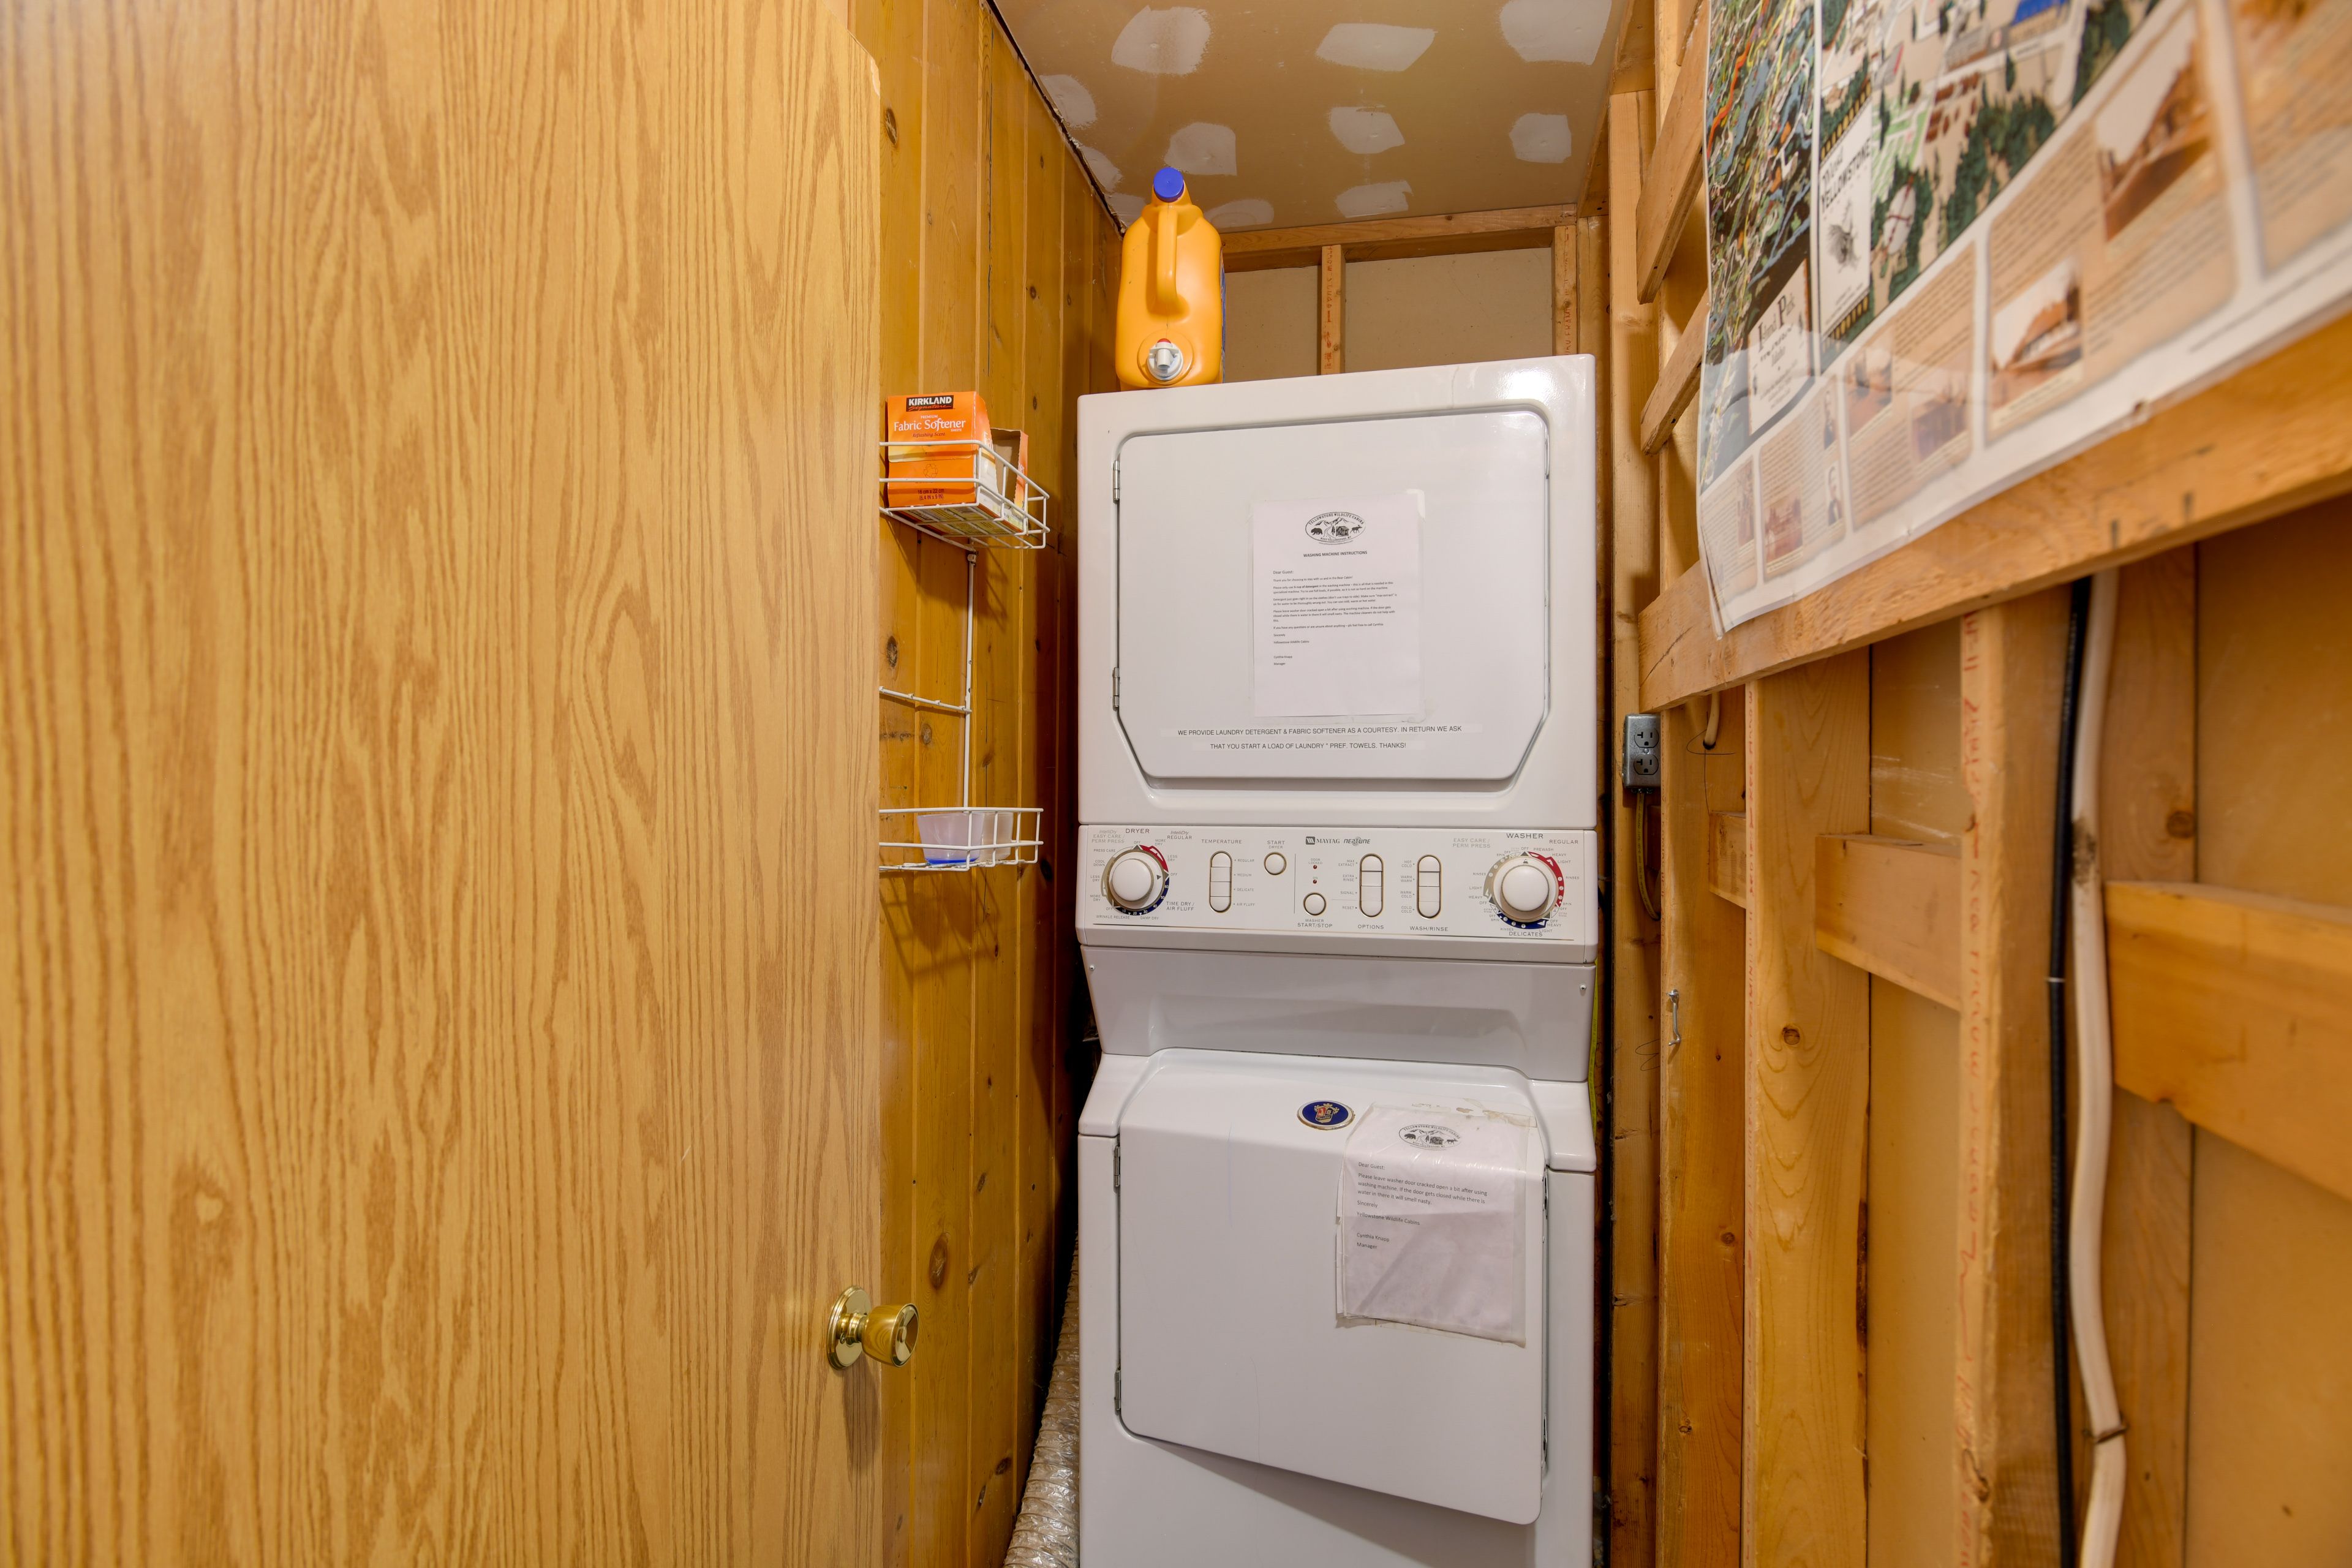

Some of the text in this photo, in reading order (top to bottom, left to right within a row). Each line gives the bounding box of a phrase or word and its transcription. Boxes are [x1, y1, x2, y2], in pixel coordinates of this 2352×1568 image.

[1822, 138, 1871, 213] YELLOWSTONE
[909, 396, 952, 406] KIRKLAND
[894, 418, 966, 431] Fabric Softener
[1357, 1212, 1385, 1220] Yellowstone
